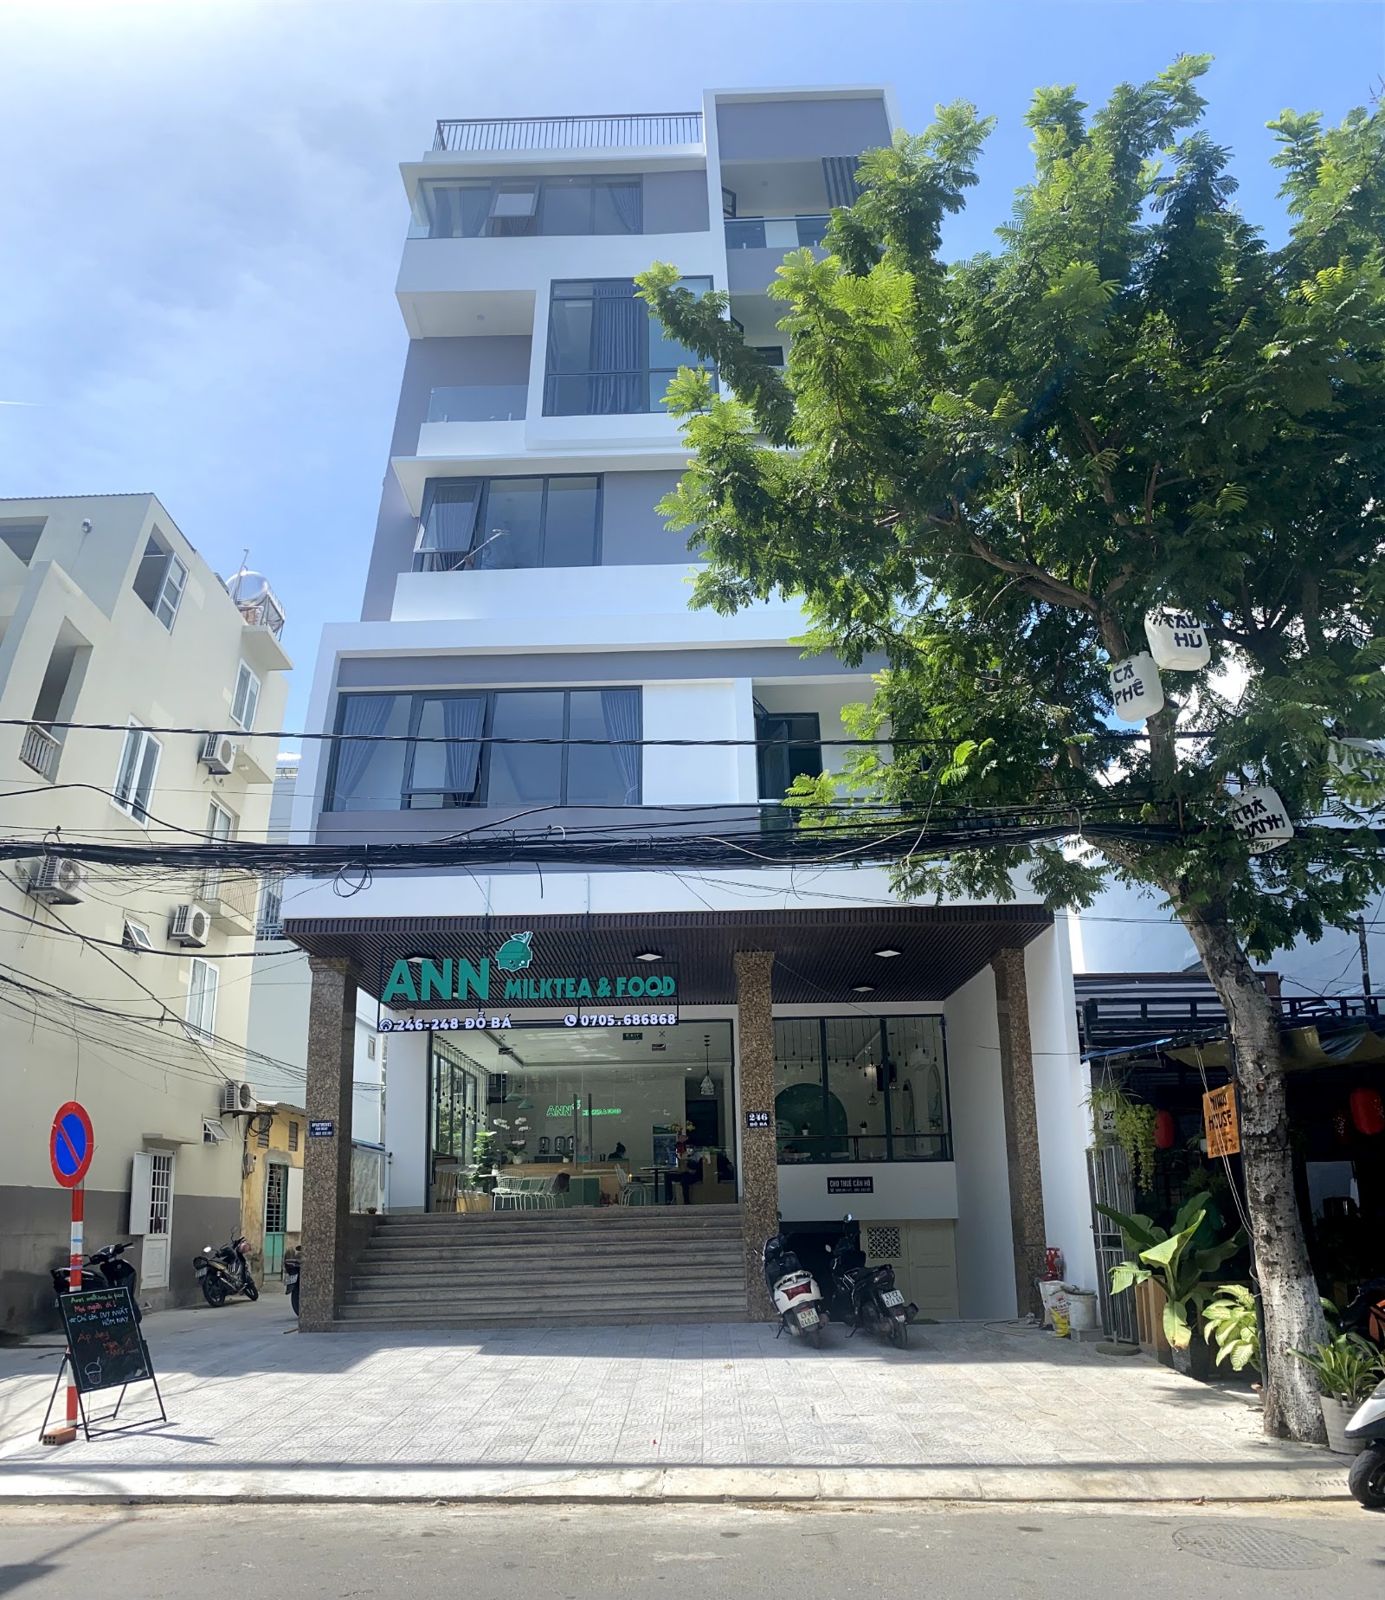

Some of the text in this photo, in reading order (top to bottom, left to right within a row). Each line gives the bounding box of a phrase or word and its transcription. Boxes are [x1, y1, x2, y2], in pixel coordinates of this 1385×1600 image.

[1114, 678, 1145, 706] PHÊ
[1232, 796, 1268, 824] TRÀ
[381, 957, 676, 1002] ANN MILKTEA & FOOD
[396, 1011, 512, 1031] 246-248 ĐỖ BÁ
[580, 1013, 677, 1027] 0705.686868
[546, 1104, 573, 1117] ANN
[749, 1112, 768, 1121] 246
